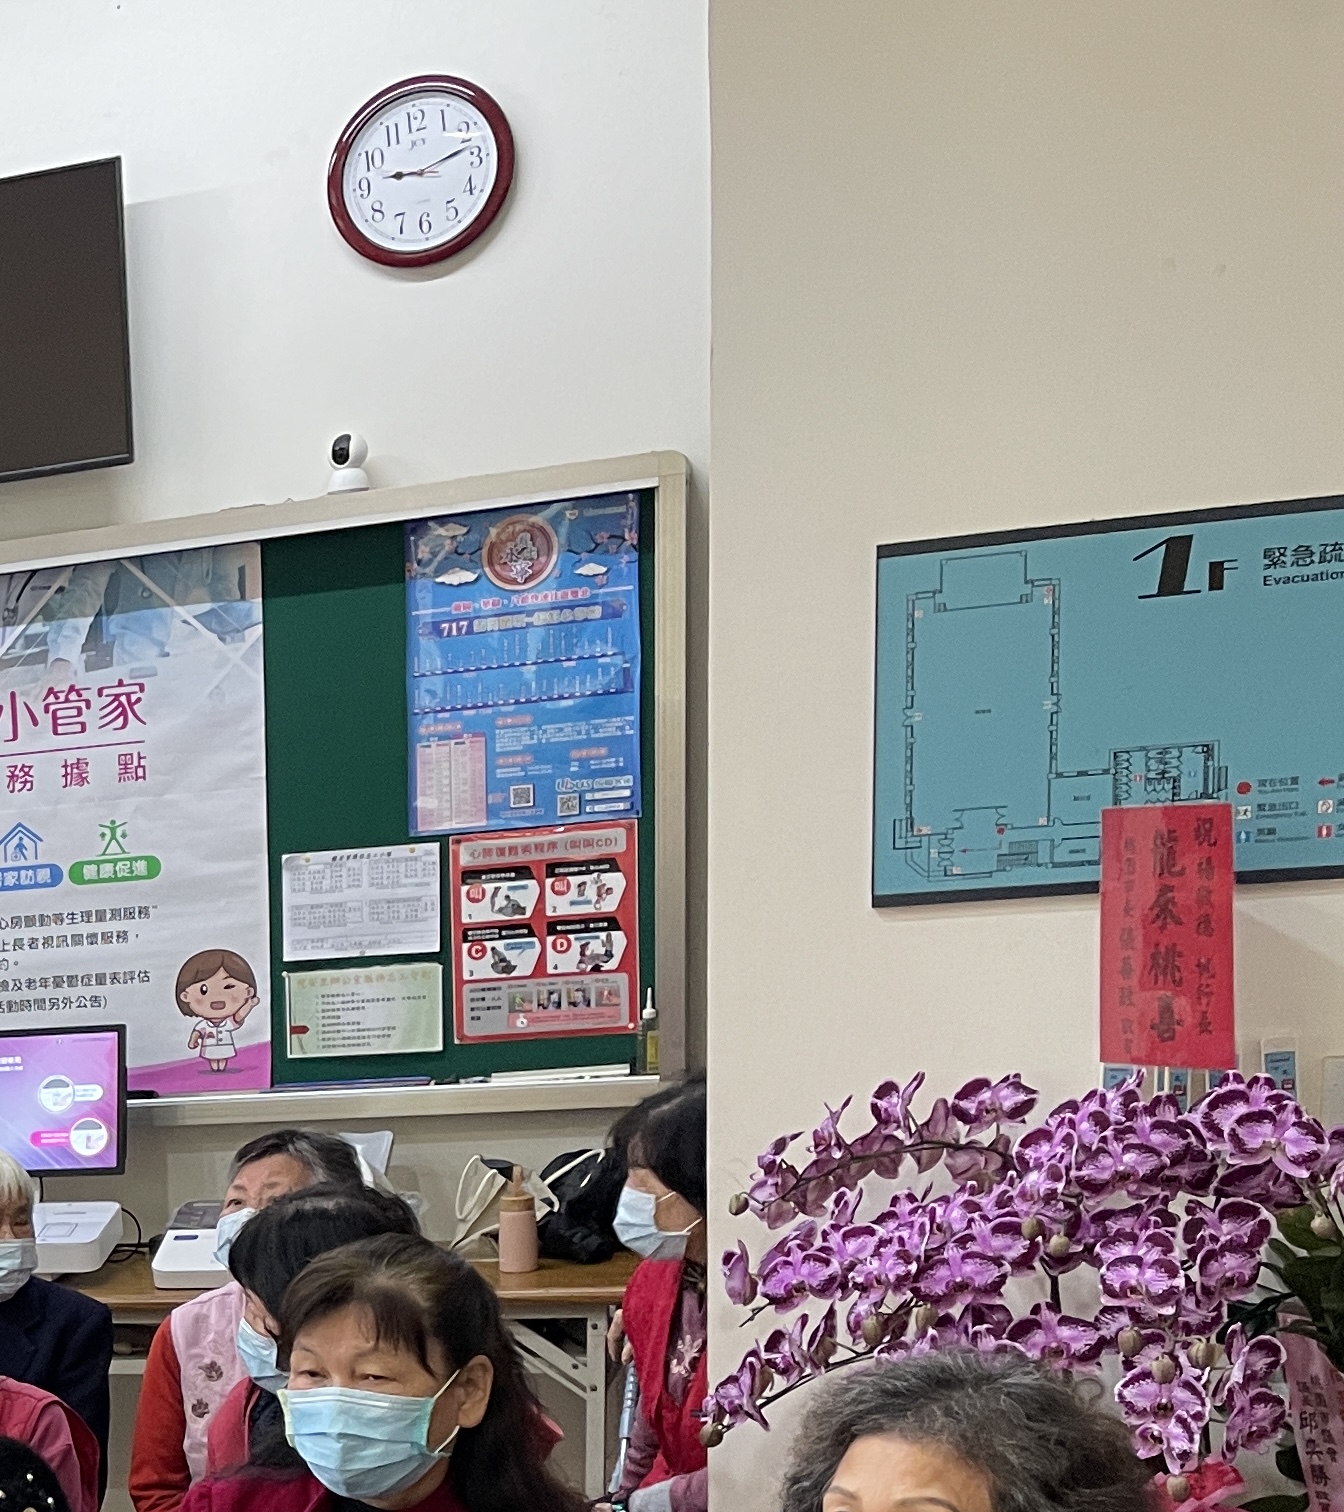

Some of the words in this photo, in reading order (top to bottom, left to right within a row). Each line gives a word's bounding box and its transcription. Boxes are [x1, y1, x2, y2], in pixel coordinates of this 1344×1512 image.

[406, 109, 427, 134] 12
[440, 109, 447, 132] 1
[385, 123, 400, 147] 11
[458, 121, 472, 144] 2
[364, 147, 385, 172] 10
[470, 145, 483, 168] 3
[358, 176, 371, 199] 9
[463, 174, 477, 196] 4
[371, 200, 385, 223] 8
[445, 198, 459, 222] 5
[394, 211, 406, 235] 7
[419, 211, 432, 235] 6
[440, 621, 469, 637] 717
